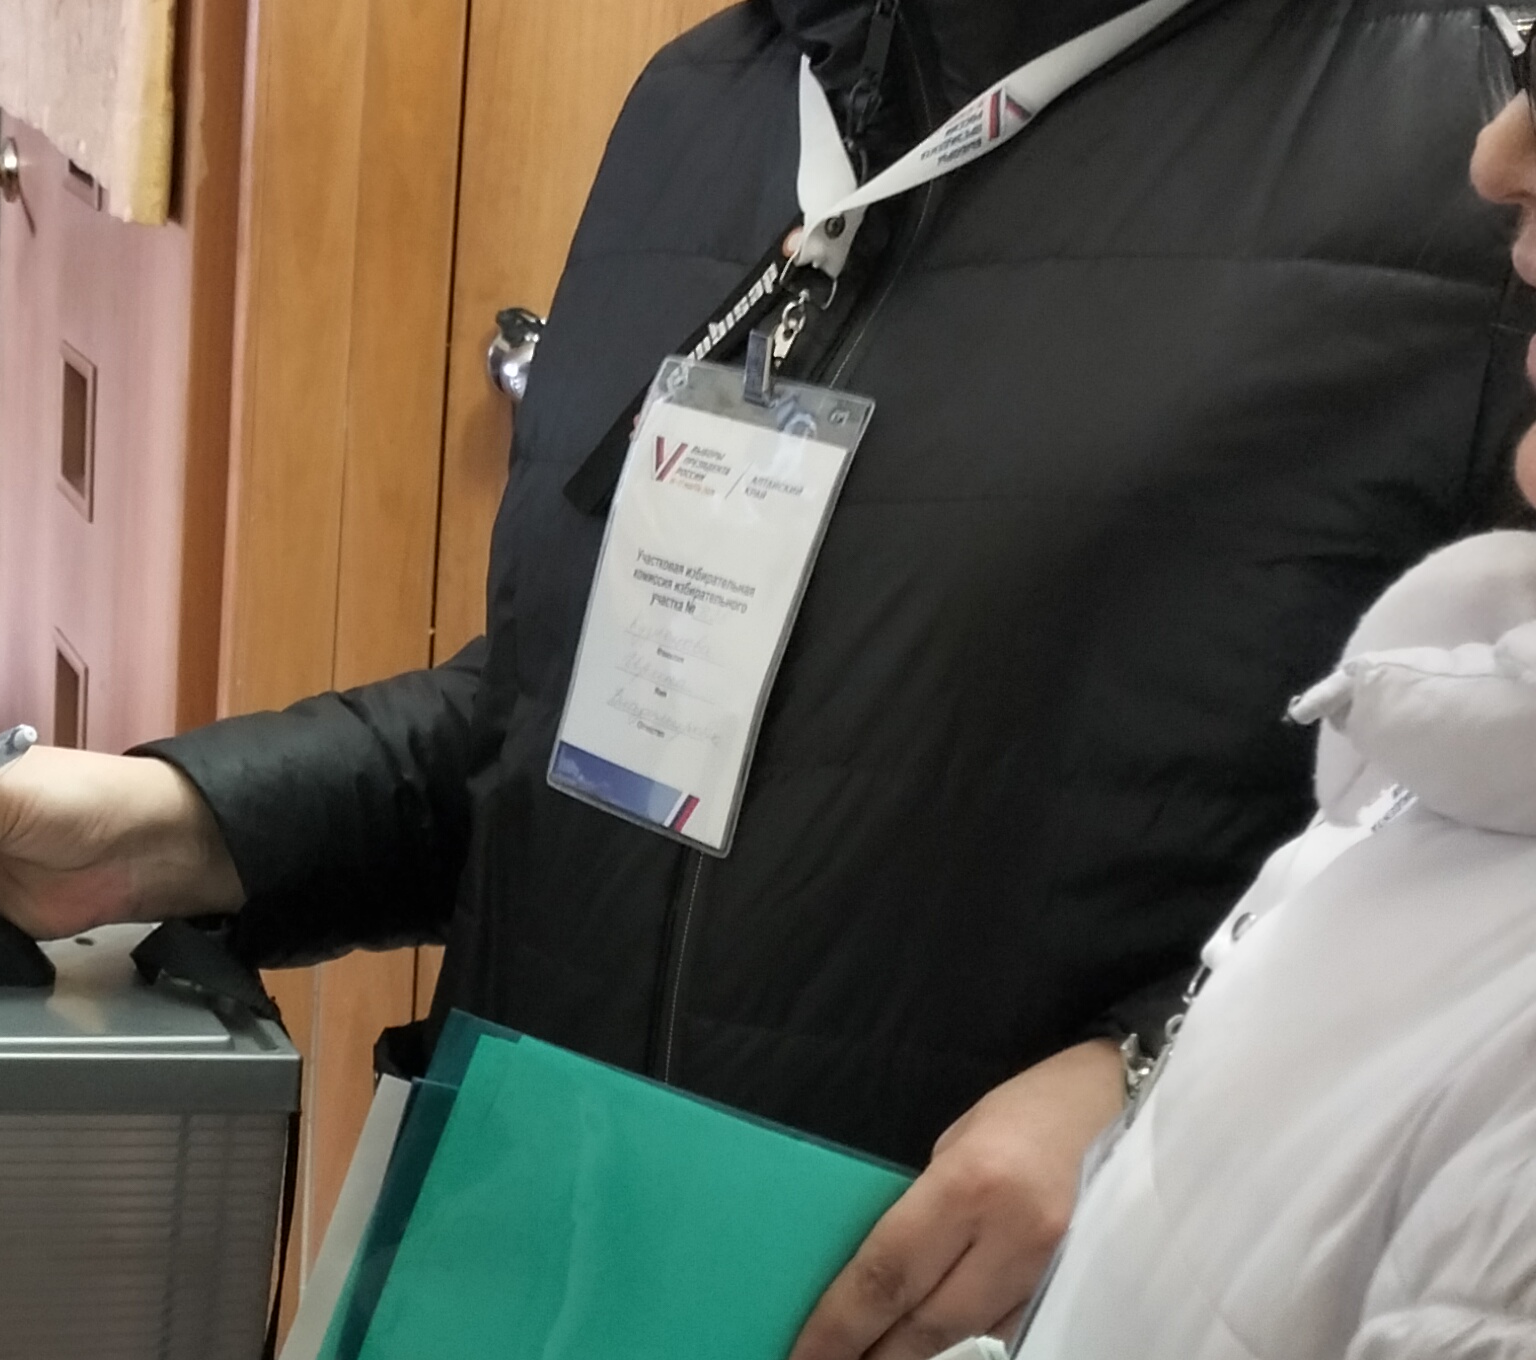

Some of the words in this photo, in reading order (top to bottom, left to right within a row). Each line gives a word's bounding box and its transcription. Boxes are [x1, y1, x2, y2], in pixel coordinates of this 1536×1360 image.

[633, 569, 673, 589] комиссия
[674, 581, 748, 614] избирательного
[636, 547, 685, 576] Участковая
[685, 567, 756, 598] избирательная
[649, 593, 684, 613] участка
